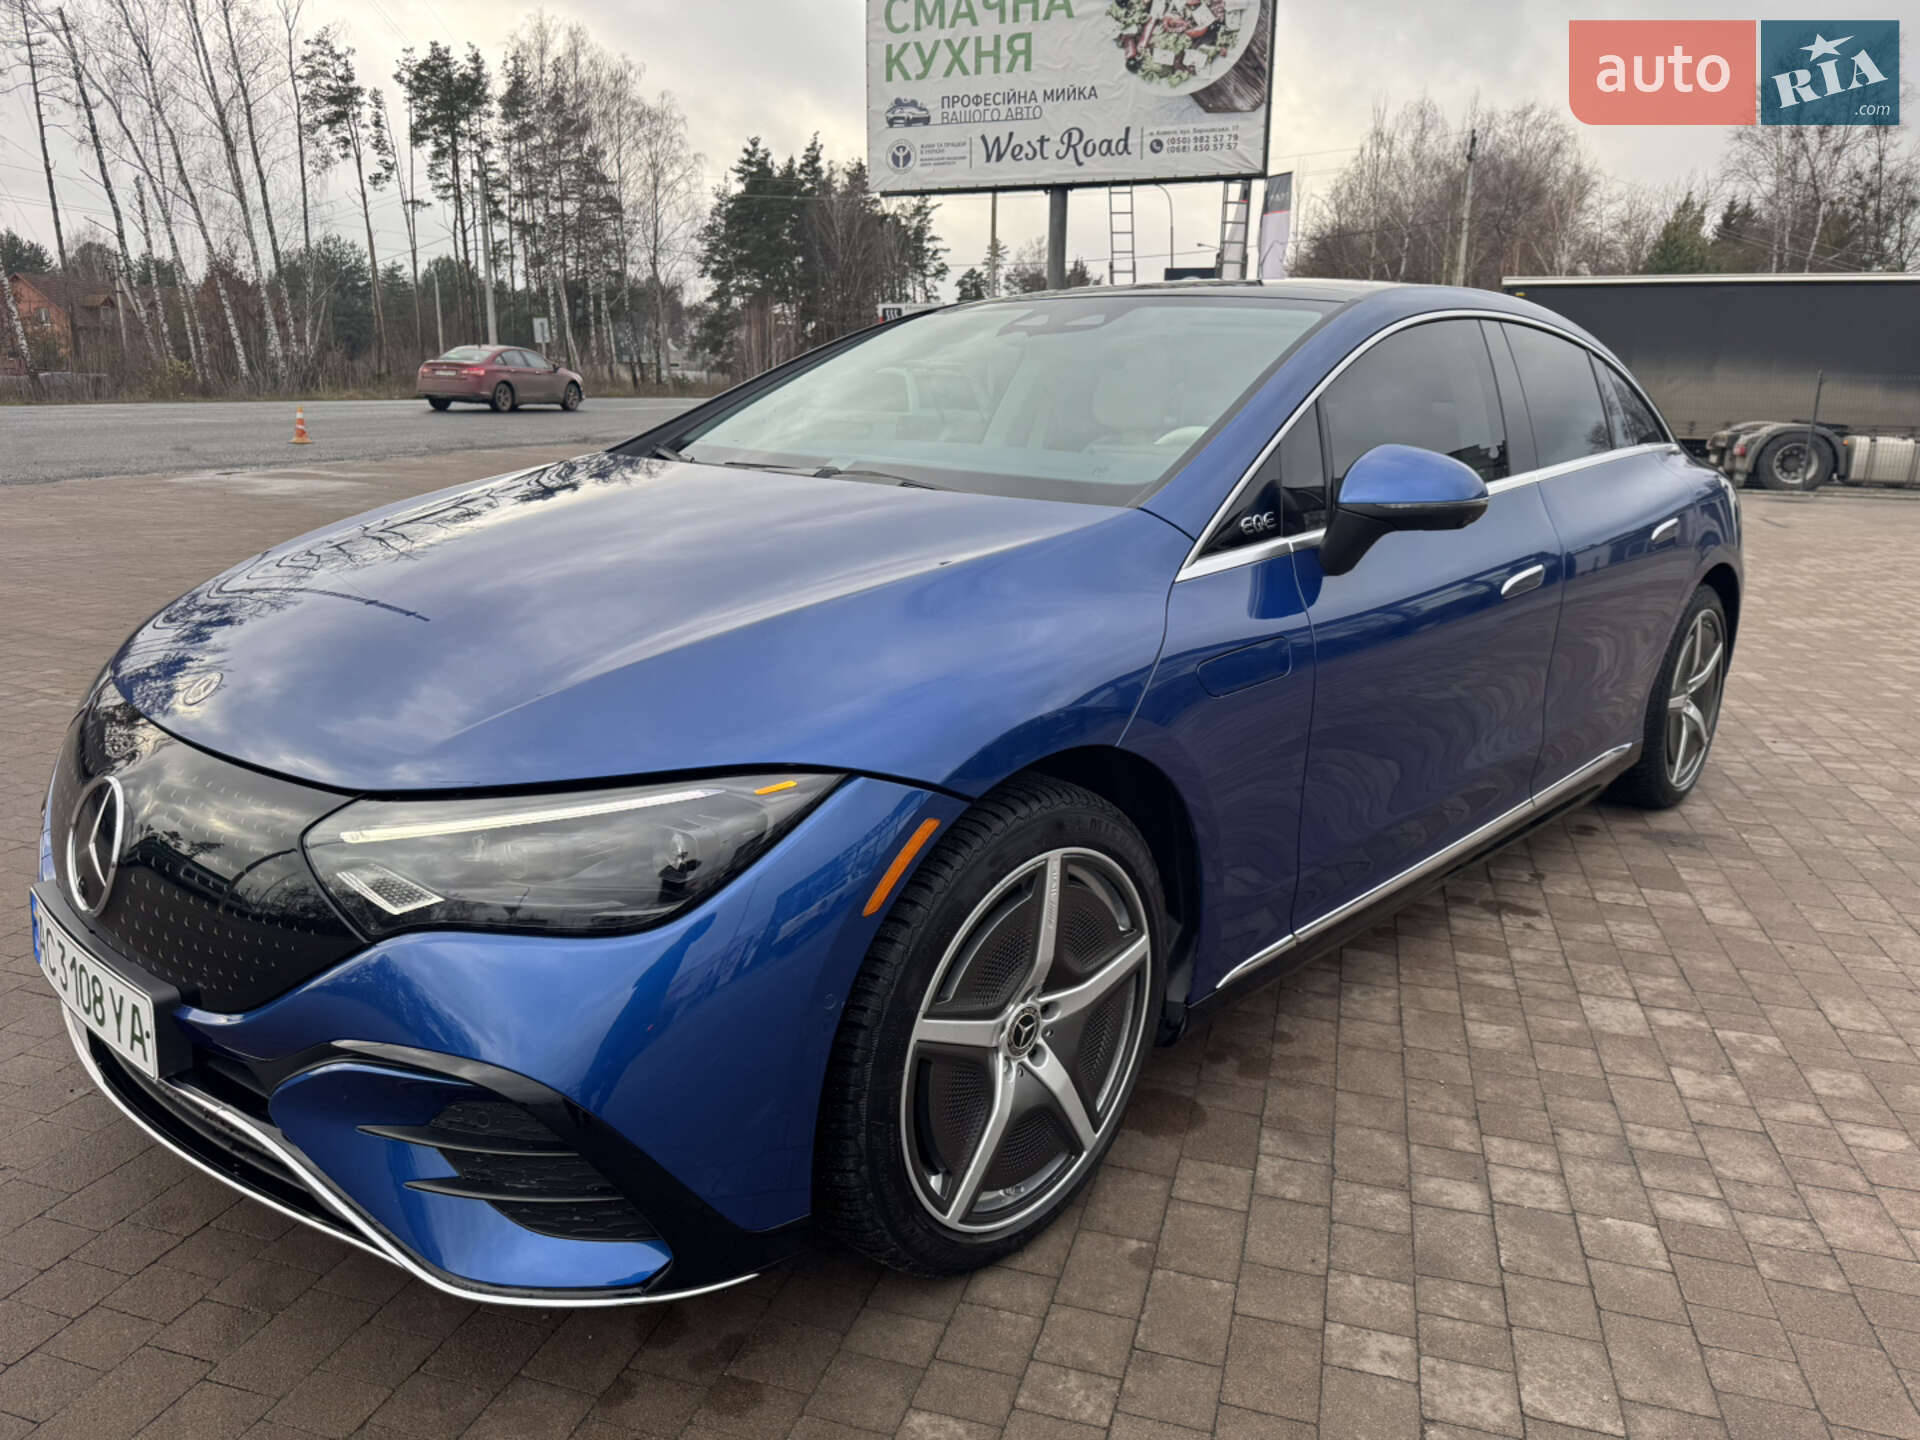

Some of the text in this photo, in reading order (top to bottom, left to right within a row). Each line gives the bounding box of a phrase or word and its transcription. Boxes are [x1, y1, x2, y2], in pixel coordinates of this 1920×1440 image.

[885, 32, 1033, 82] КУХНЯ
[941, 84, 1098, 109] ПРОФЕСІЙНА МИЙКА
[941, 105, 1043, 124] ВАШОГО АВТО
[980, 126, 1132, 167] West Road
[1240, 511, 1278, 535] EQE
